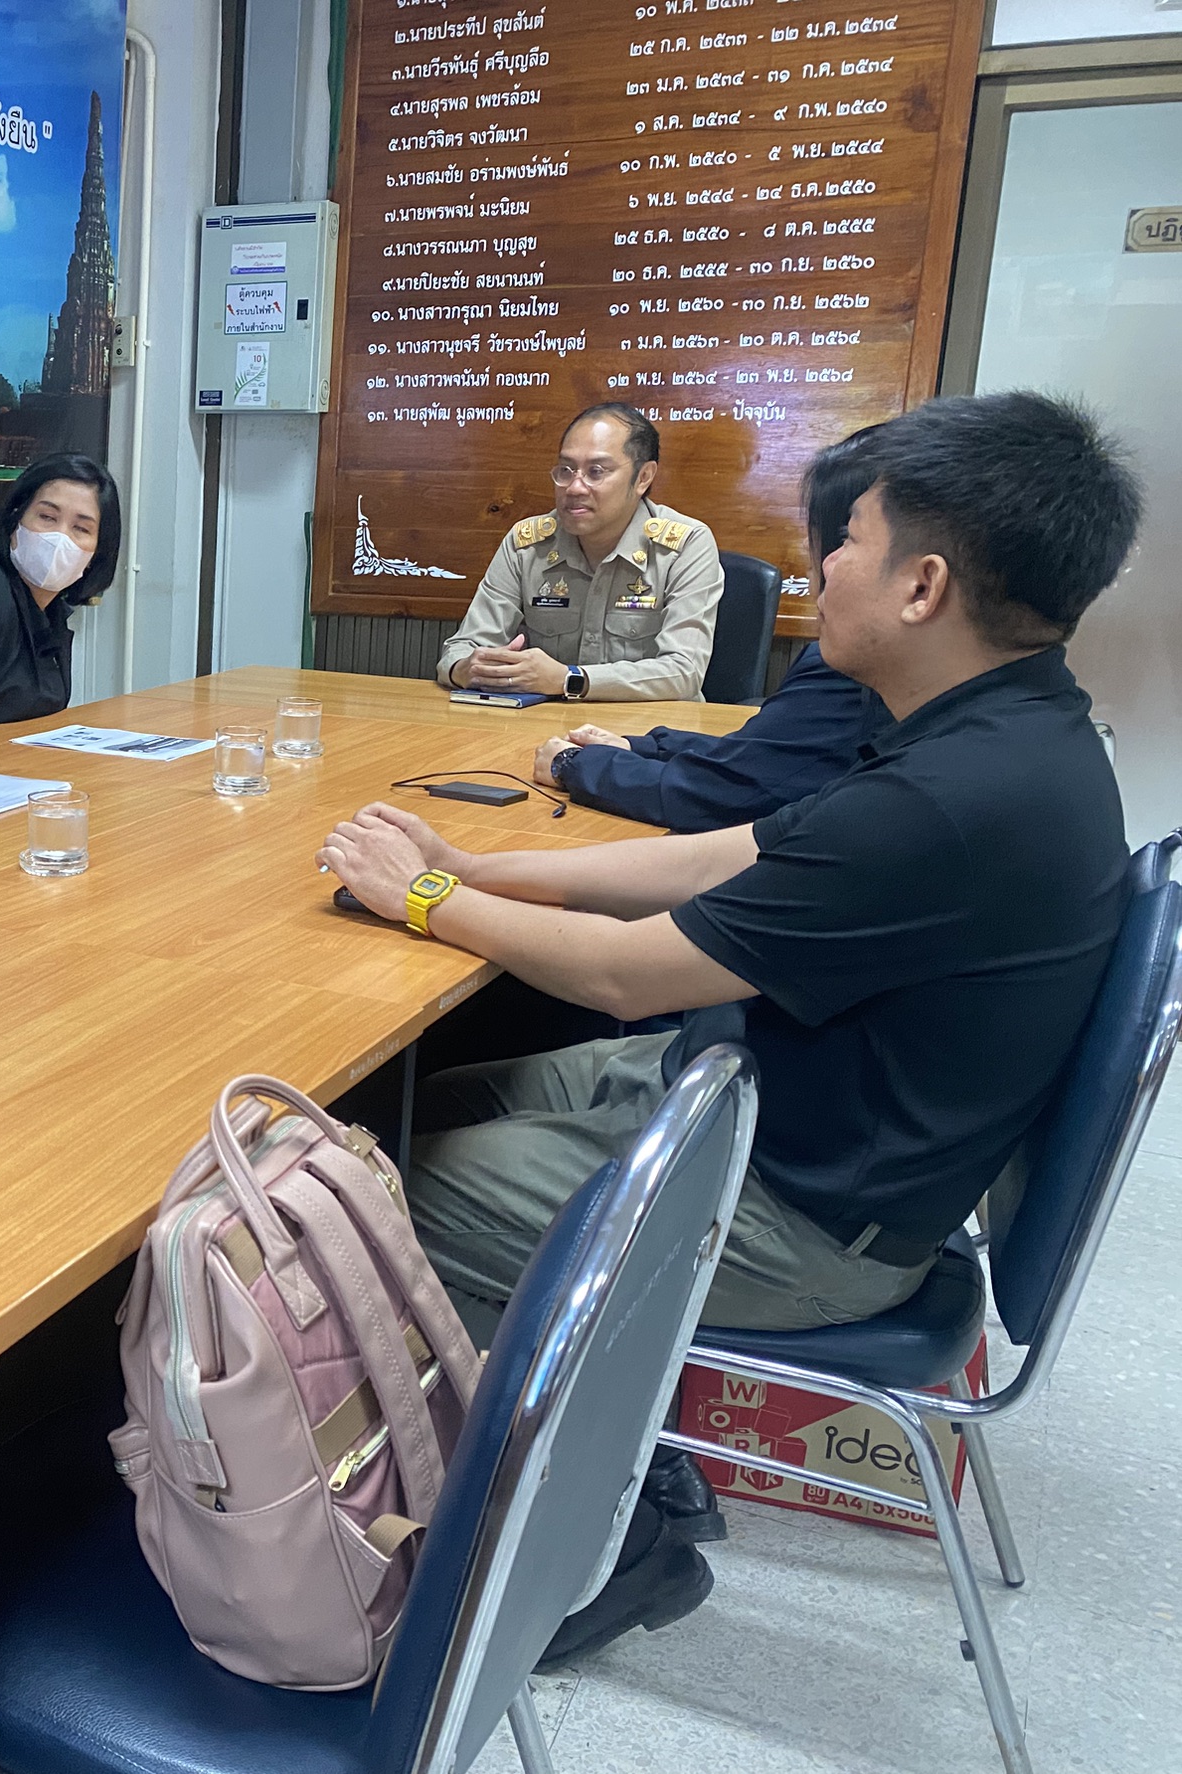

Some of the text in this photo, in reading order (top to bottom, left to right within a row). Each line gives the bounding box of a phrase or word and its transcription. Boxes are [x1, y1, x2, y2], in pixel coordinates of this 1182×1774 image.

[636, 6, 656, 20] ๑๐
[630, 40, 655, 56] ๒๕
[661, 37, 690, 53] ก.ค.
[700, 33, 747, 49] ๒๕๓๓
[771, 26, 799, 42] ๒๒
[806, 21, 840, 38] ม.ค.
[845, 15, 898, 34] ๒๕๓๔
[626, 81, 649, 95] ๒๓
[657, 76, 688, 92] ม.ค.
[696, 70, 745, 89] ๒๕๓๔
[768, 70, 790, 83] ๓๑
[803, 62, 835, 79] ก.ค.
[841, 56, 894, 76] ๒๕๓๔
[635, 121, 645, 134] ๑
[653, 115, 683, 131] ส.ค.
[692, 110, 741, 128] ๒๕๓๔
[774, 106, 788, 121] ๙
[799, 102, 831, 118] ก.พ.
[836, 98, 887, 116] ๒๕๔๐
[620, 160, 640, 173] ๑๐
[650, 154, 680, 169] ก.พ.
[689, 150, 737, 167] ๒๕๔๐
[768, 146, 781, 161] ๕
[792, 143, 825, 159] พ.ย.
[831, 138, 884, 156] ๒๕๔๔
[629, 195, 639, 208] ๖
[647, 192, 677, 207] พ.ย.
[686, 188, 734, 205] ๒๕๔๔
[756, 185, 783, 200] ๒๔
[791, 182, 822, 198] ธ.ค.
[825, 179, 876, 196] ๒๕๕๐
[614, 231, 639, 245] ๒๕
[644, 229, 673, 244] ธ.ค.
[683, 226, 729, 242] ๒๕๕๐
[764, 223, 776, 237] ๘
[785, 221, 817, 236] ต.ค.
[823, 218, 876, 235] ๒๕๕๕
[1145, 217, 1182, 242] ปฏิ
[613, 269, 635, 282] ๒๐
[643, 266, 671, 280] ธ.ค.
[680, 263, 728, 278] ๒๕๕๕
[750, 262, 772, 276] ๓๐
[779, 257, 814, 272] ก.ย.
[823, 255, 875, 270] ๒๕๖๐
[239, 287, 273, 301] ตู้ควบคุม
[236, 305, 275, 315] ระบบไฟฟ้า
[372, 311, 394, 322] ๑๐.
[609, 303, 629, 316] ๑๐
[639, 299, 669, 313] พ.ย.
[678, 297, 724, 312] ๒๕๖๐
[742, 299, 765, 311] ๓๐
[774, 295, 806, 310] ก.ย.
[815, 293, 869, 309] ๒๕๖๒
[227, 322, 283, 332] ภายในสำนักงาน
[368, 344, 390, 355] ๑๑.
[621, 340, 631, 350] ๓
[638, 335, 667, 349] ม.ค.
[672, 334, 719, 348] ๒๕๖๓
[740, 333, 764, 347] ๒๐
[771, 332, 803, 345] ต.ค.
[811, 330, 860, 345] ๒๕๖๔
[367, 376, 389, 389] ๑๒.
[608, 373, 629, 388] ๑๒
[636, 372, 665, 385] พ.ย.
[672, 371, 717, 385] ๒๕๖๔
[736, 370, 758, 383] ๒๓
[767, 369, 797, 382] พ.ย.
[806, 368, 853, 382] ๒๕๖๘
[368, 411, 388, 422] ๑๓.
[670, 407, 714, 421] ๒๕๖๘
[726, 1379, 758, 1403] W
[832, 1491, 863, 1511] A4
